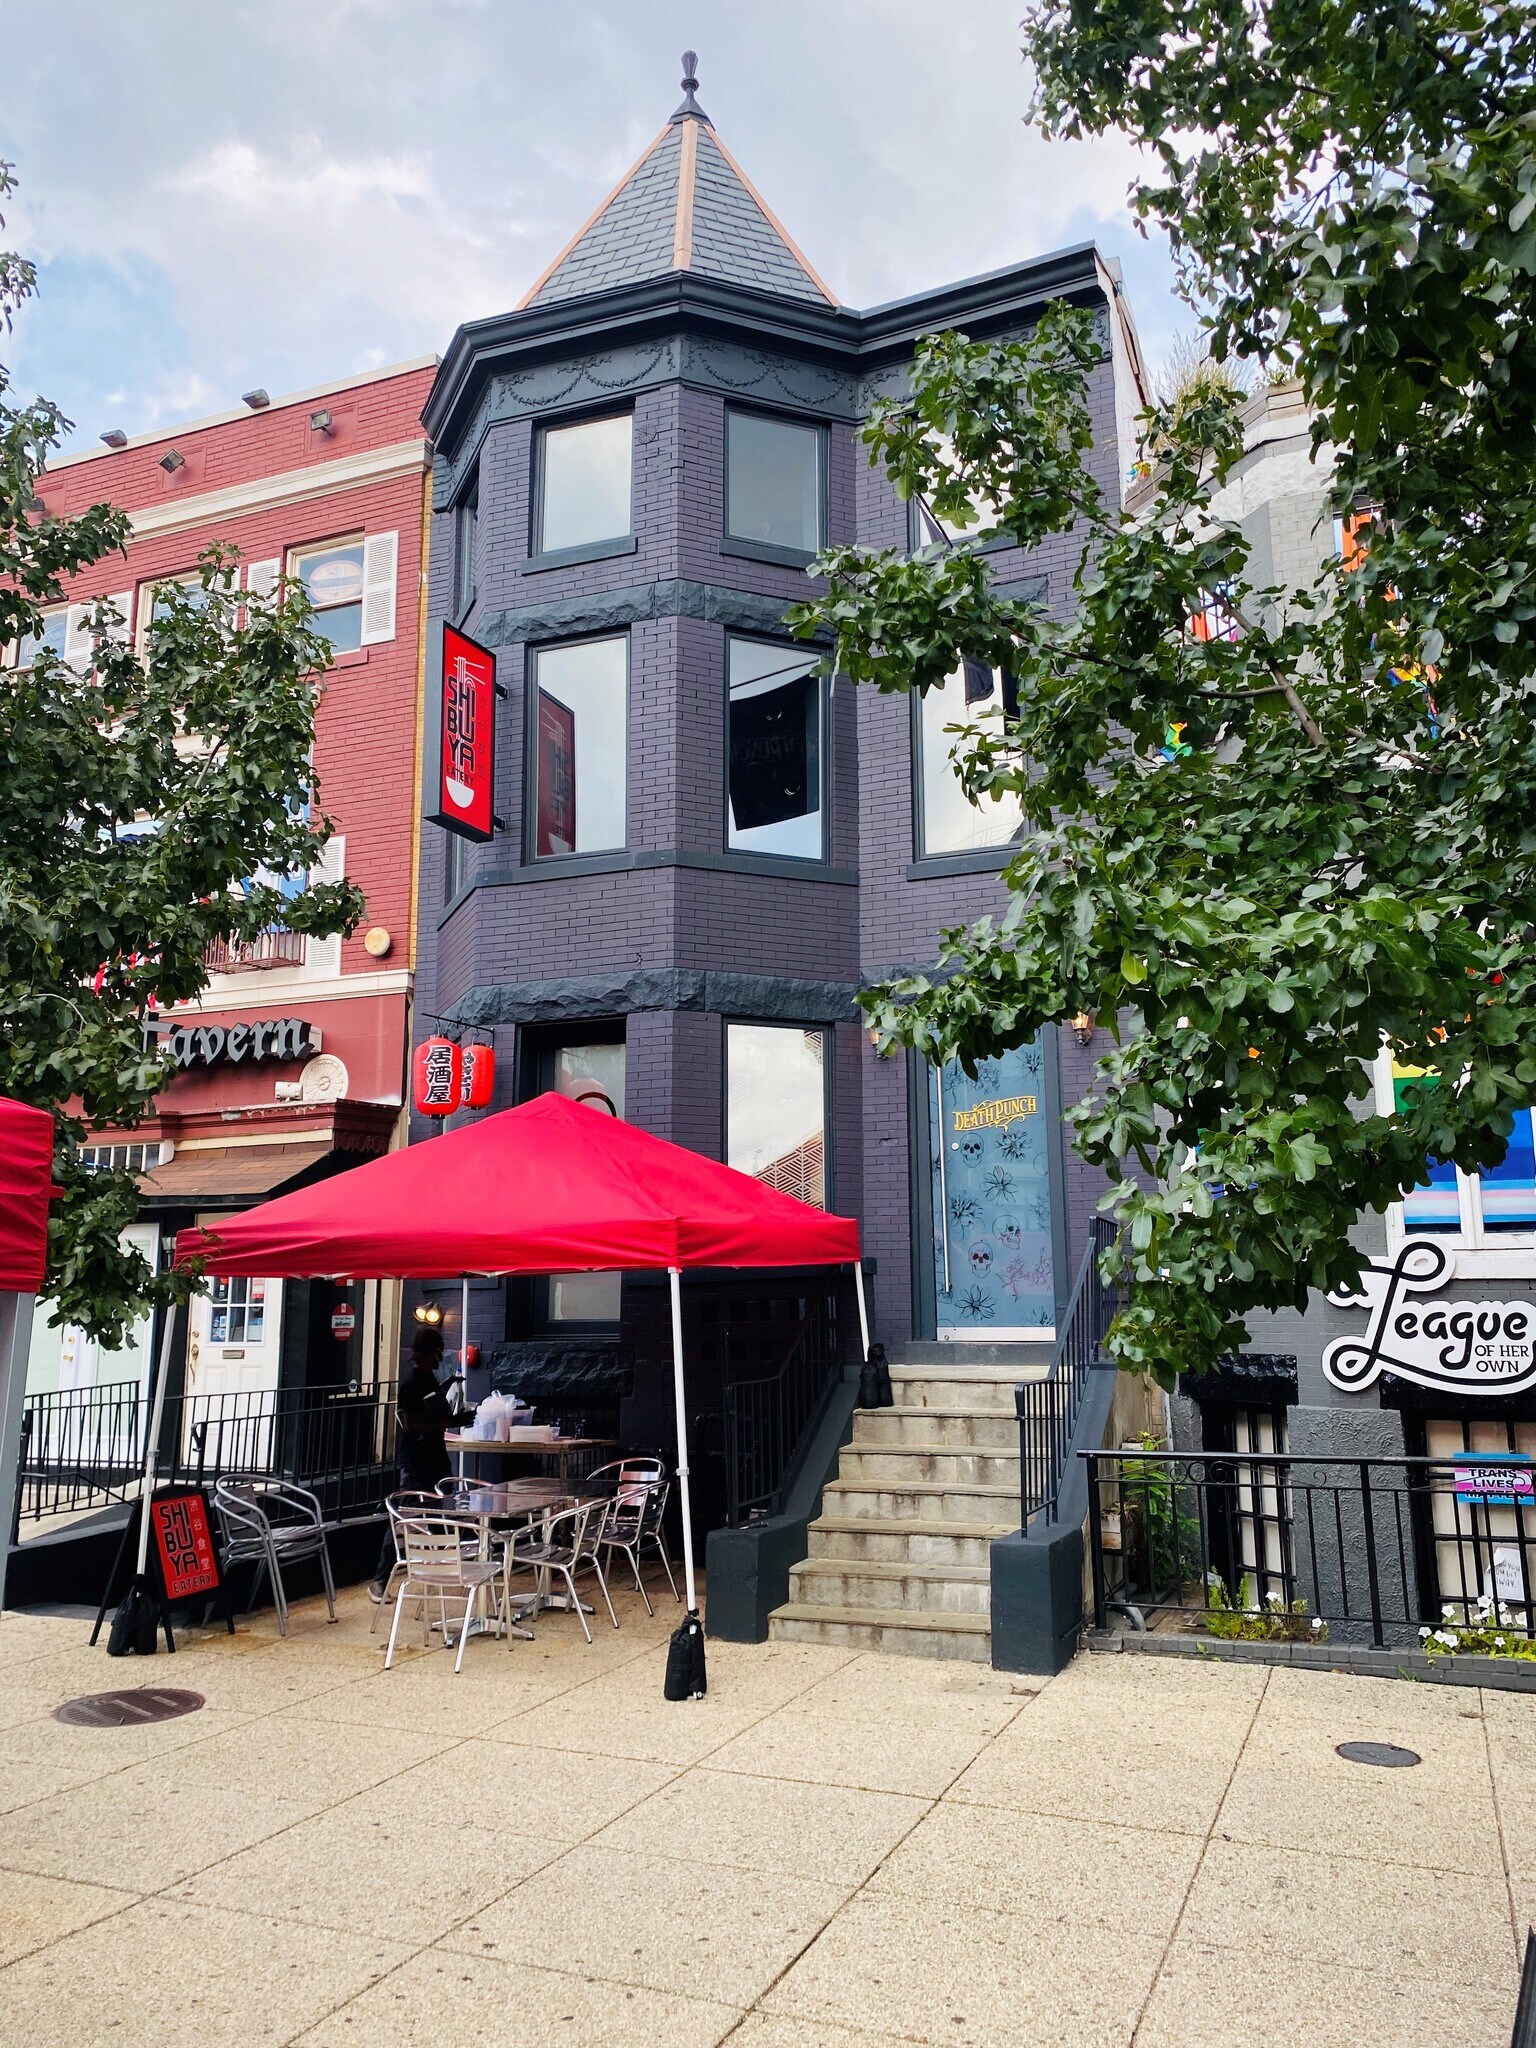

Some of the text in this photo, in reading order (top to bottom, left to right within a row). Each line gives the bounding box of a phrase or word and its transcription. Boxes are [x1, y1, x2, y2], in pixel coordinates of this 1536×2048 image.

[446, 763, 475, 787] EATERY
[139, 1011, 311, 1068] Tavern
[423, 1045, 453, 1104] 居酒屋
[954, 1098, 1037, 1131] DEATH PUNCH
[1328, 1241, 1531, 1386] League
[1474, 1344, 1530, 1358] OF HER
[1476, 1360, 1520, 1373] OWN
[1468, 1468, 1517, 1478] TRANS
[1473, 1479, 1515, 1488] LIVES
[169, 1551, 200, 1576] YA
[172, 1573, 213, 1594] EATERY
